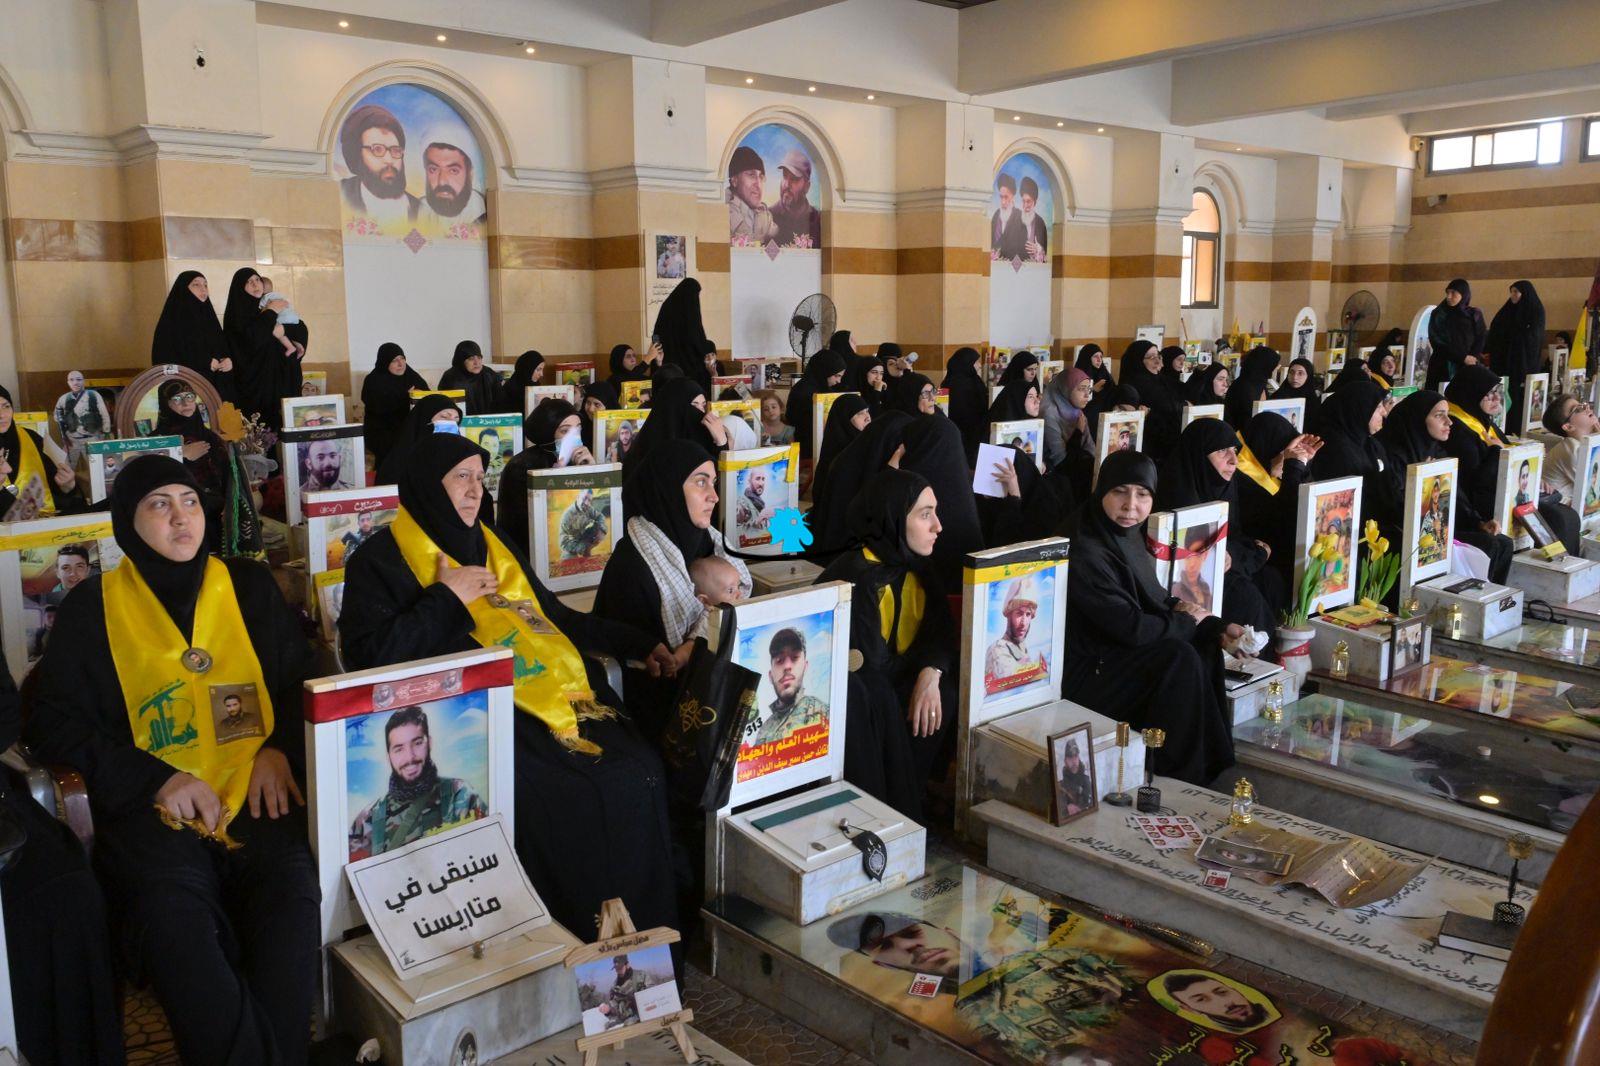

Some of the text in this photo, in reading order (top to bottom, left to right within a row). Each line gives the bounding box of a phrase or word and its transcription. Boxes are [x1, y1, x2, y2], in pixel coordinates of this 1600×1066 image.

[745, 717, 763, 737] 313
[776, 734, 801, 755] العلم
[385, 853, 499, 913] سنبقى في
[413, 896, 502, 938] متاريسنا
